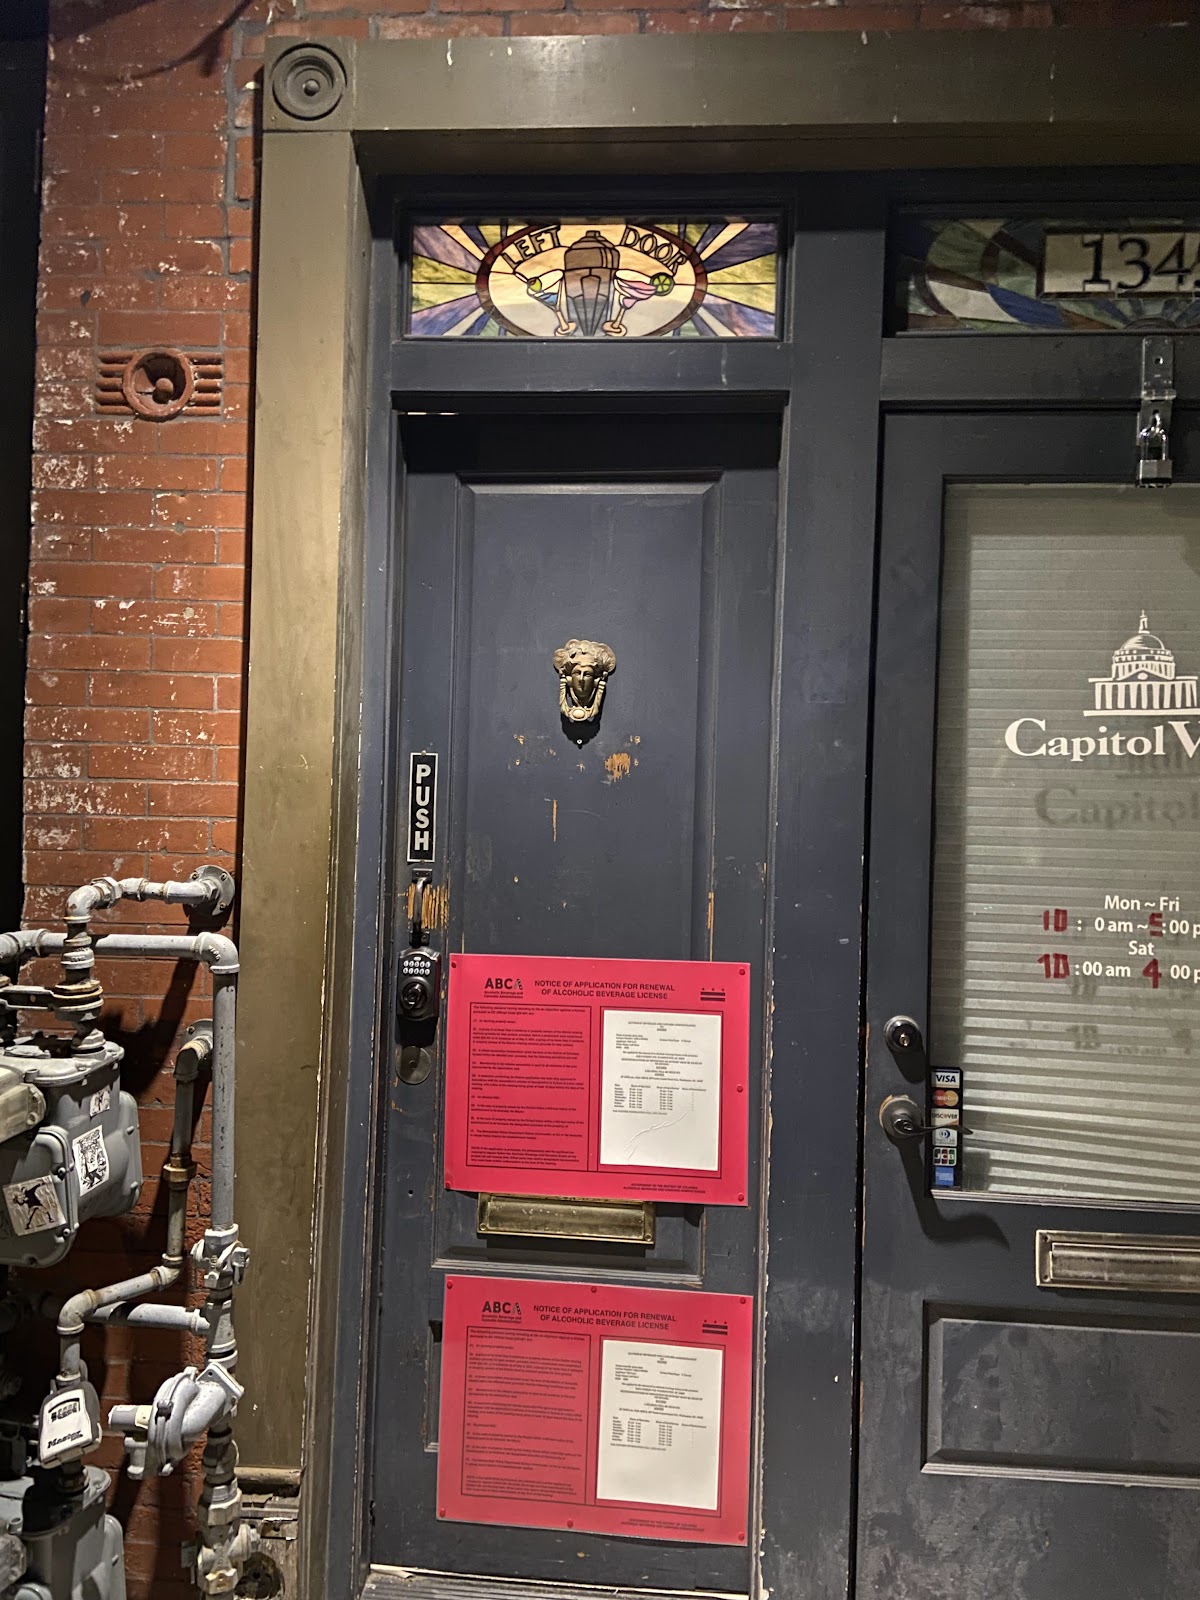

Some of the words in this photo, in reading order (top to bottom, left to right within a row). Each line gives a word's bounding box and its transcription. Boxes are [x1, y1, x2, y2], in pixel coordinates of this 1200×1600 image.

[501, 225, 561, 271] LEFT
[620, 227, 687, 275] DOOR
[1081, 234, 1200, 290] 134
[415, 764, 431, 850] PUSH
[1104, 895, 1141, 911] Mon
[1159, 896, 1180, 912] Fri
[1128, 940, 1155, 956] Sat
[1142, 958, 1162, 989] 4
[534, 980, 561, 988] NOTICE
[574, 981, 622, 990] APPLICATION
[623, 983, 638, 991] FOR
[639, 984, 675, 992] RENEWAL
[541, 988, 551, 996] OF
[552, 989, 594, 997] ALCOHOLIC
[596, 990, 636, 998] BEVERAGE
[637, 991, 668, 1000] LICENSE
[936, 1074, 956, 1083] VISA
[533, 1304, 560, 1313] NOTICE
[562, 1306, 572, 1314] OF
[574, 1307, 622, 1318] APPLICATION
[623, 1310, 639, 1319] FOR
[640, 1311, 677, 1322] RENEWAL
[540, 1314, 551, 1322] OF
[552, 1314, 594, 1325] ALCOHOLIC
[596, 1317, 637, 1328] BEVERAGE
[637, 1320, 670, 1330] LICENSE
